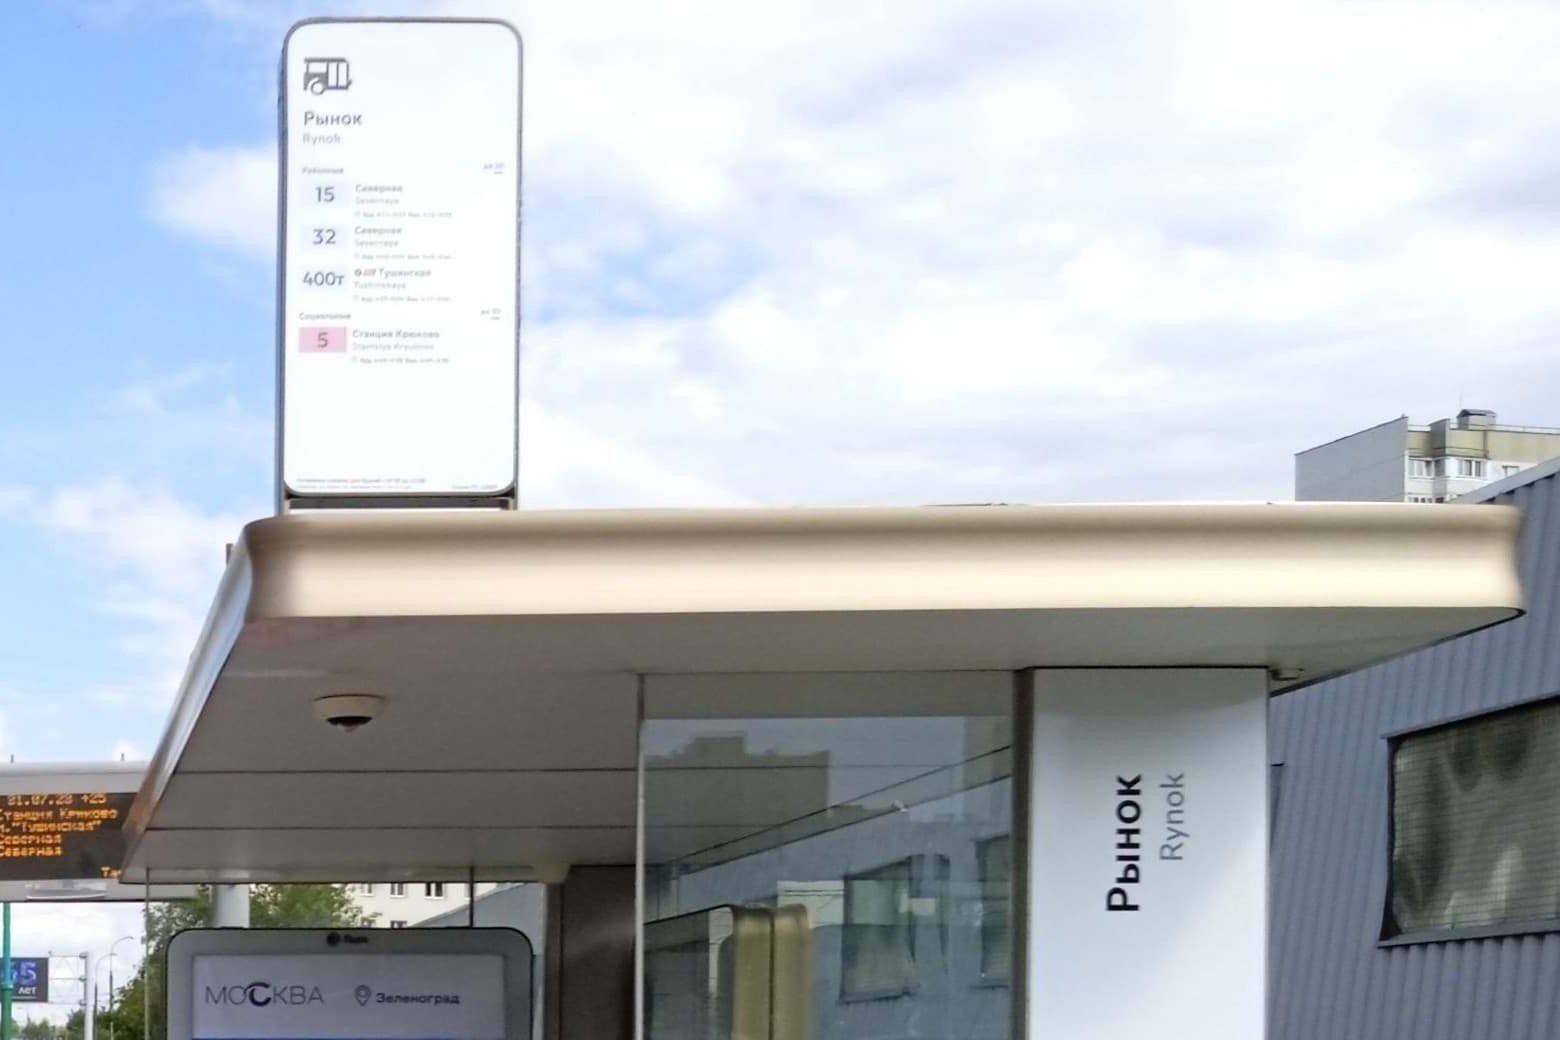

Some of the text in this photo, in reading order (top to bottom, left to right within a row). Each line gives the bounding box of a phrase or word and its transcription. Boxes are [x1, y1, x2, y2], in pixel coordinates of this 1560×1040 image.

[303, 110, 363, 127] Рынок
[302, 132, 342, 146] Rynok
[314, 186, 336, 203] 15
[312, 228, 337, 246] 32
[302, 271, 345, 287] 400т
[316, 331, 329, 349] 5
[1158, 773, 1190, 860] Rynok
[1105, 773, 1142, 912] Рынок
[205, 981, 324, 1007] МОСКВА
[375, 992, 460, 1006] Зеленоград
